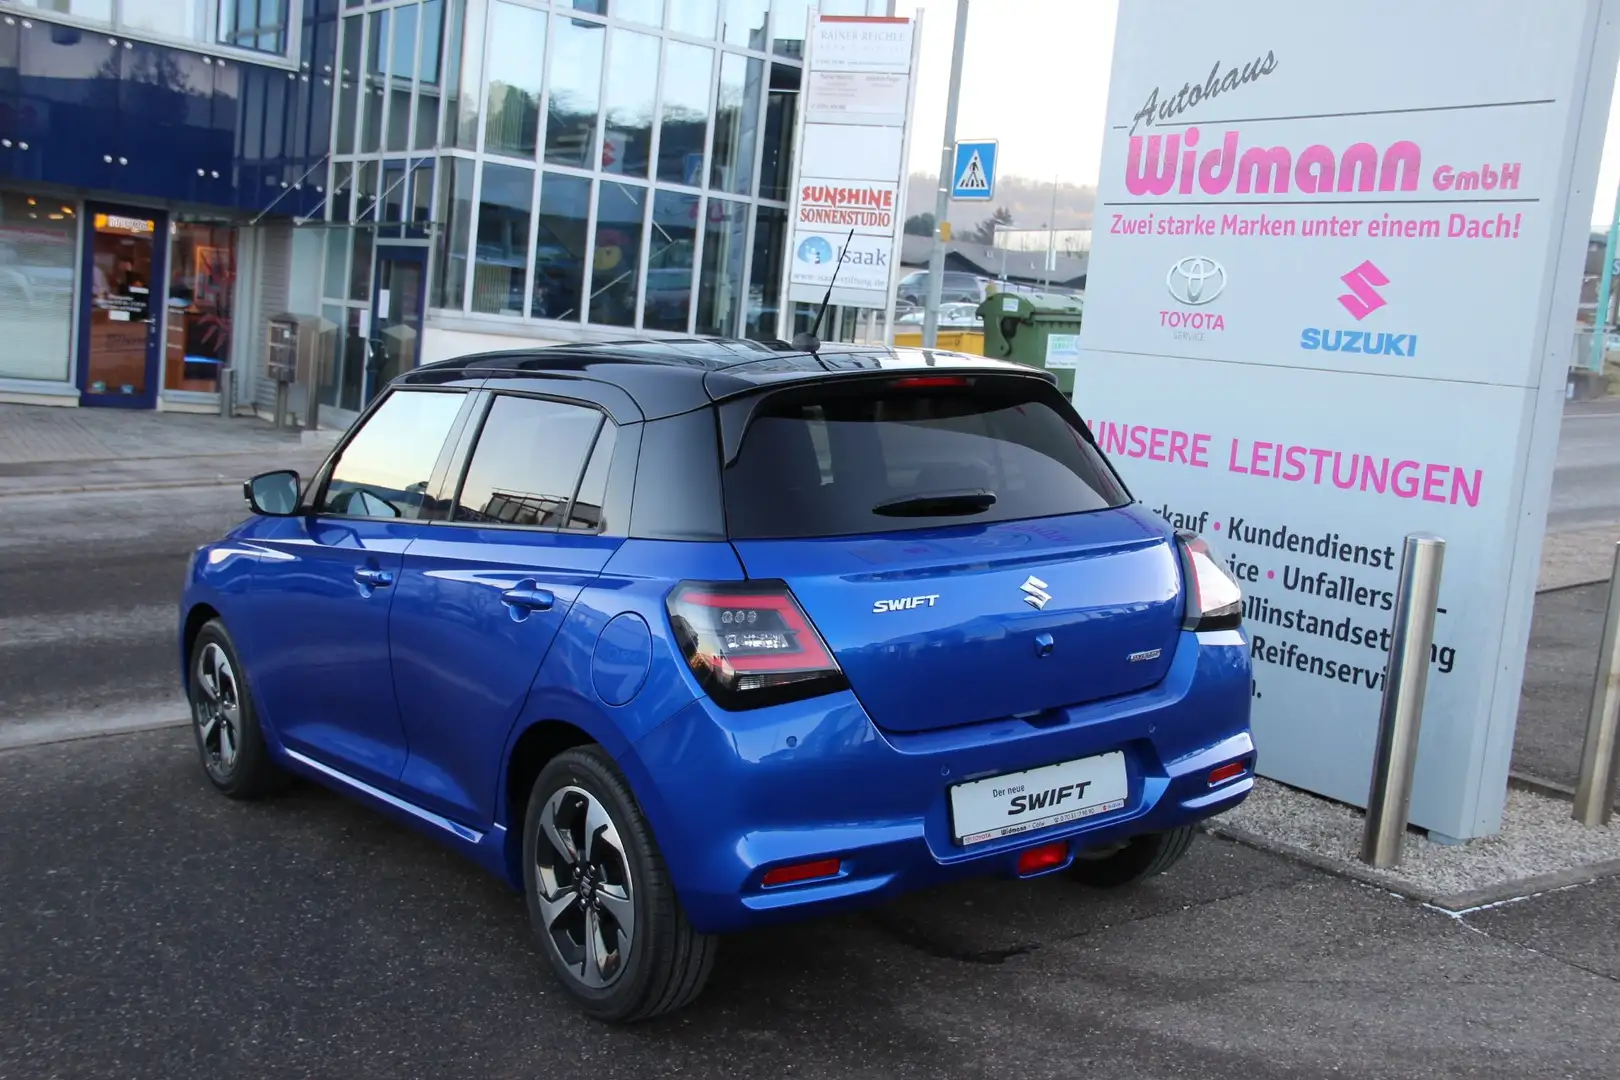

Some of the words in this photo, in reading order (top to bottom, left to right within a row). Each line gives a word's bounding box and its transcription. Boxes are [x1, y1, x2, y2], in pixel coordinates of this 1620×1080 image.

[1129, 50, 1278, 136] Autohaus
[1124, 127, 1422, 196] Widmann
[1432, 163, 1522, 191] GmbH
[802, 184, 893, 209] SUNSHINE
[800, 207, 891, 228] SONNENSTUDIO
[1110, 213, 1154, 235] Zwei
[1156, 213, 1216, 236] starke
[1220, 213, 1296, 237] Marken
[1301, 215, 1363, 237] unter
[1367, 213, 1440, 238] einem
[1447, 212, 1523, 239] Dach!
[836, 245, 888, 267] Isaak
[1159, 311, 1225, 331] TOYOTA
[1300, 328, 1417, 357] SUZUKI
[1228, 438, 1484, 508] LEISTUNGEN
[1227, 516, 1396, 571] Kundendienst
[872, 594, 940, 614] SWIFT
[1251, 635, 1386, 692] Reifenservi
[992, 788, 1006, 799] Der
[1007, 783, 1025, 796] neue
[1007, 781, 1092, 816] SWIFT
